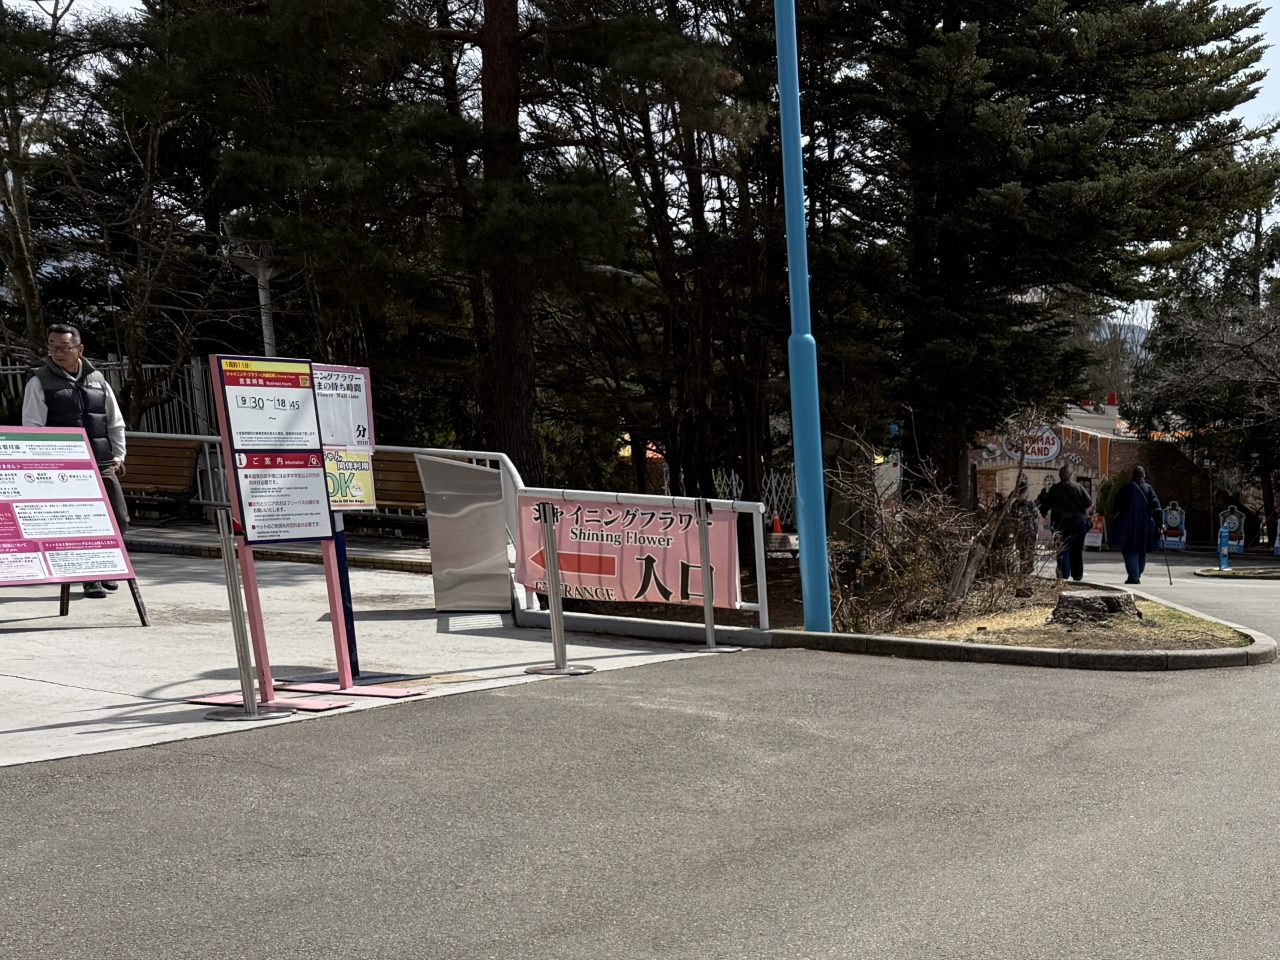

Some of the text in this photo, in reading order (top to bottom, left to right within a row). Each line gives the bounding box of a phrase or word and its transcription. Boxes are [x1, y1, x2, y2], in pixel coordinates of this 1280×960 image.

[316, 381, 362, 393] まの待ち時間
[241, 396, 247, 405] 9
[251, 396, 265, 410] 30
[277, 398, 286, 408] 18
[290, 400, 300, 410] 45
[356, 424, 367, 438] 分
[252, 456, 284, 466] ご案内
[326, 472, 356, 498] OK
[570, 527, 673, 547] Shining Flower
[634, 555, 715, 603] 入口
[535, 581, 617, 601] ERANCE
